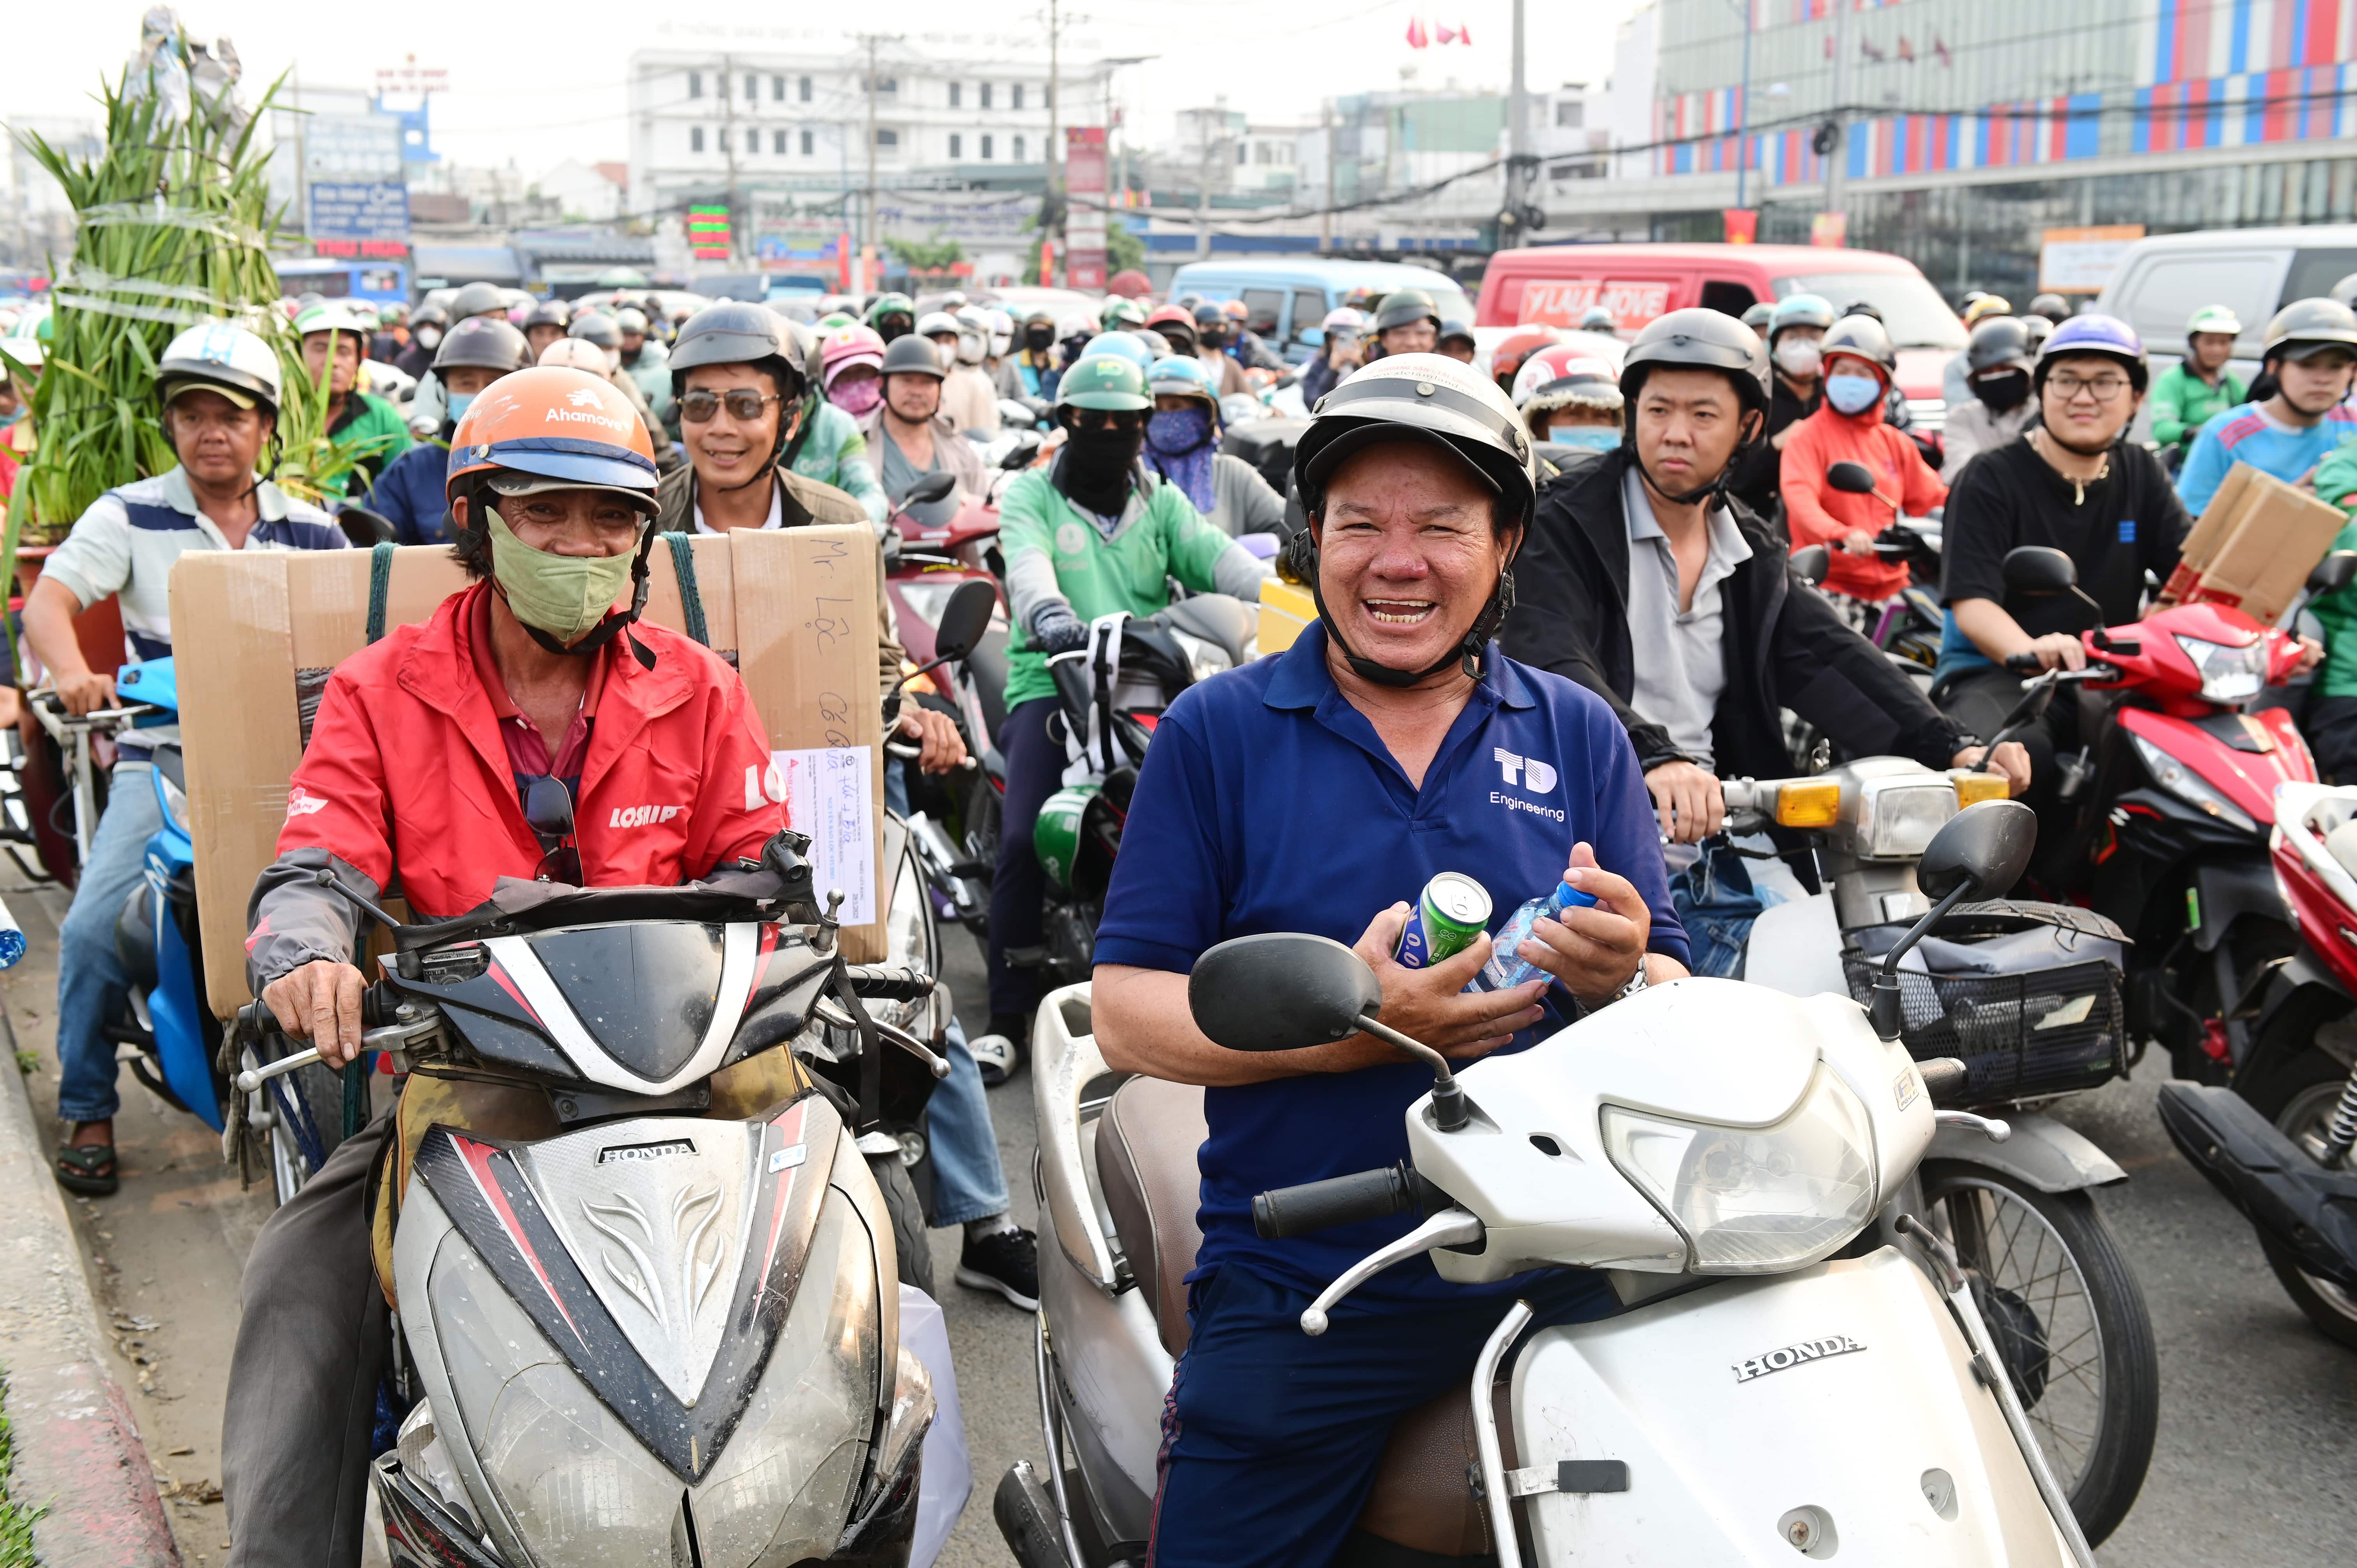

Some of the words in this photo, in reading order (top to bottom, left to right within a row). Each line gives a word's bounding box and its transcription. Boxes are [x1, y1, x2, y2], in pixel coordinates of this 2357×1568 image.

[545, 408, 625, 431] Ahamove
[799, 455, 832, 473] Grab
[1494, 747, 1557, 794] TD
[609, 805, 685, 828] LOSHIP
[1490, 791, 1564, 822] Engineering
[603, 1143, 693, 1163] HONDA
[1731, 1333, 1868, 1384] HONDA
